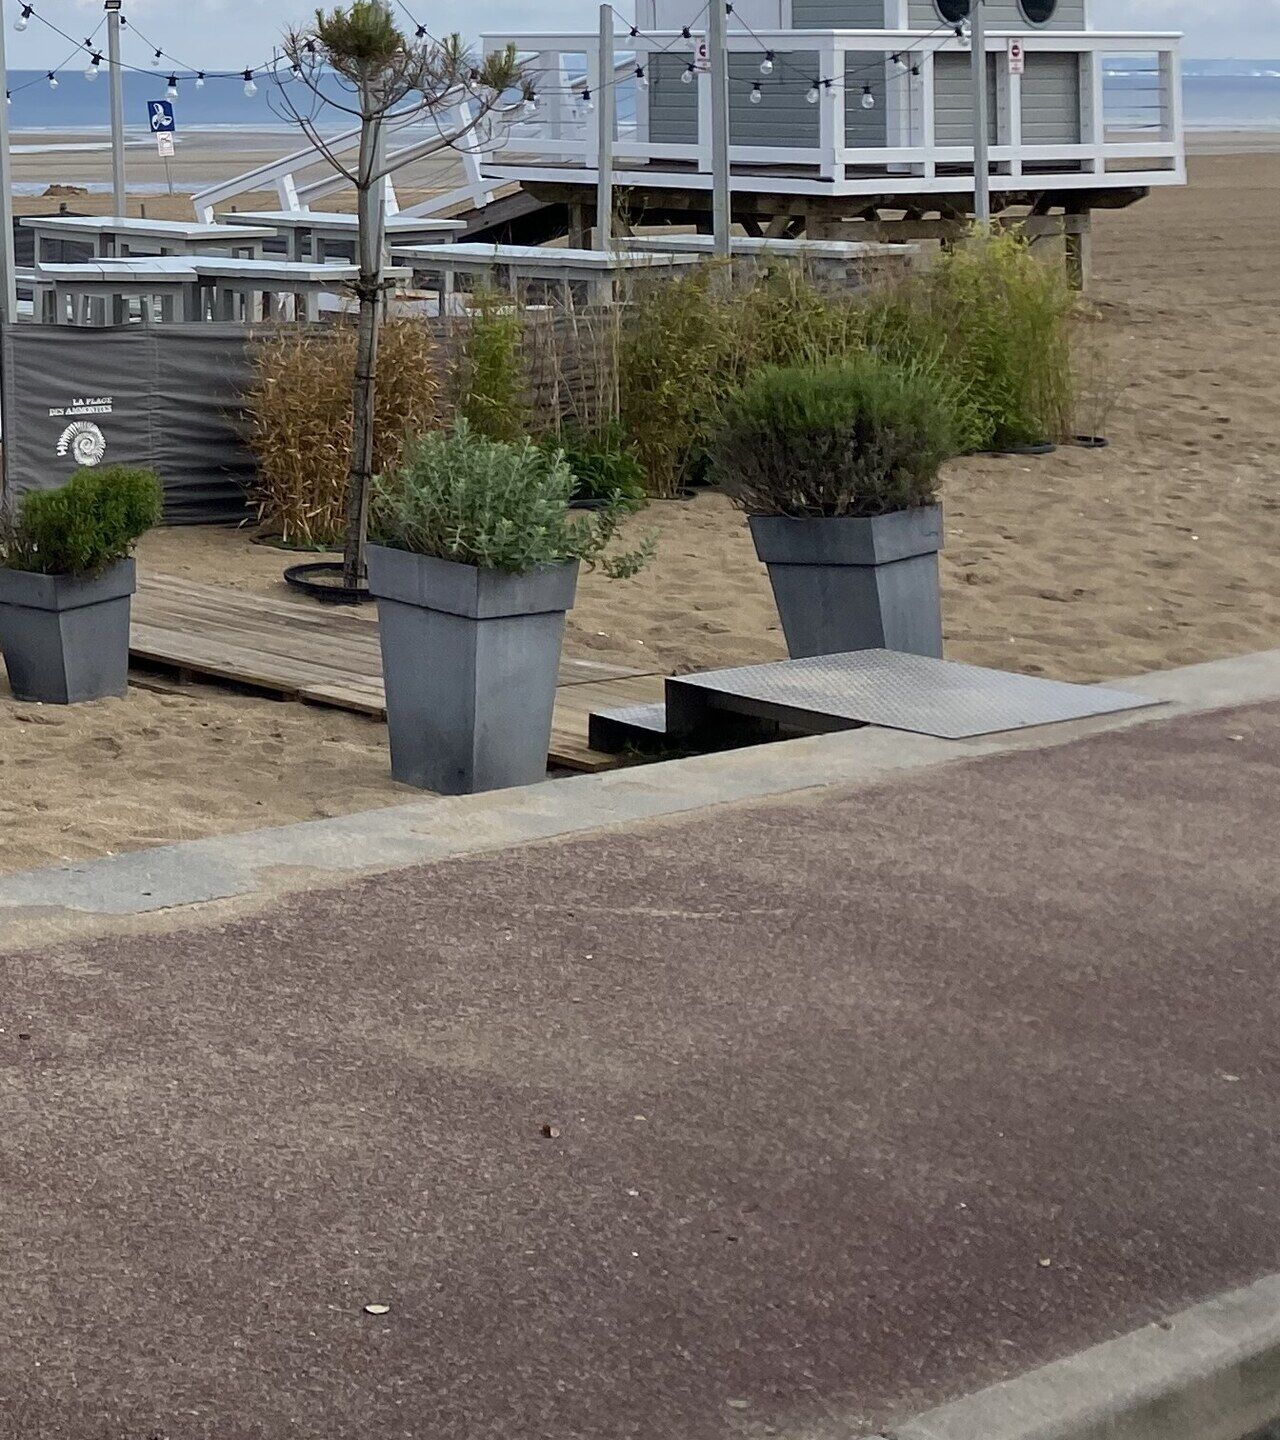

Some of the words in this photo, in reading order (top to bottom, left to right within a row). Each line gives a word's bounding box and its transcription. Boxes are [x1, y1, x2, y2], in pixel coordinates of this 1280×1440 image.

[72, 398, 85, 406] LA
[86, 396, 113, 405] PLAGE
[49, 408, 65, 416] DES
[65, 405, 112, 415] AMMONITES
